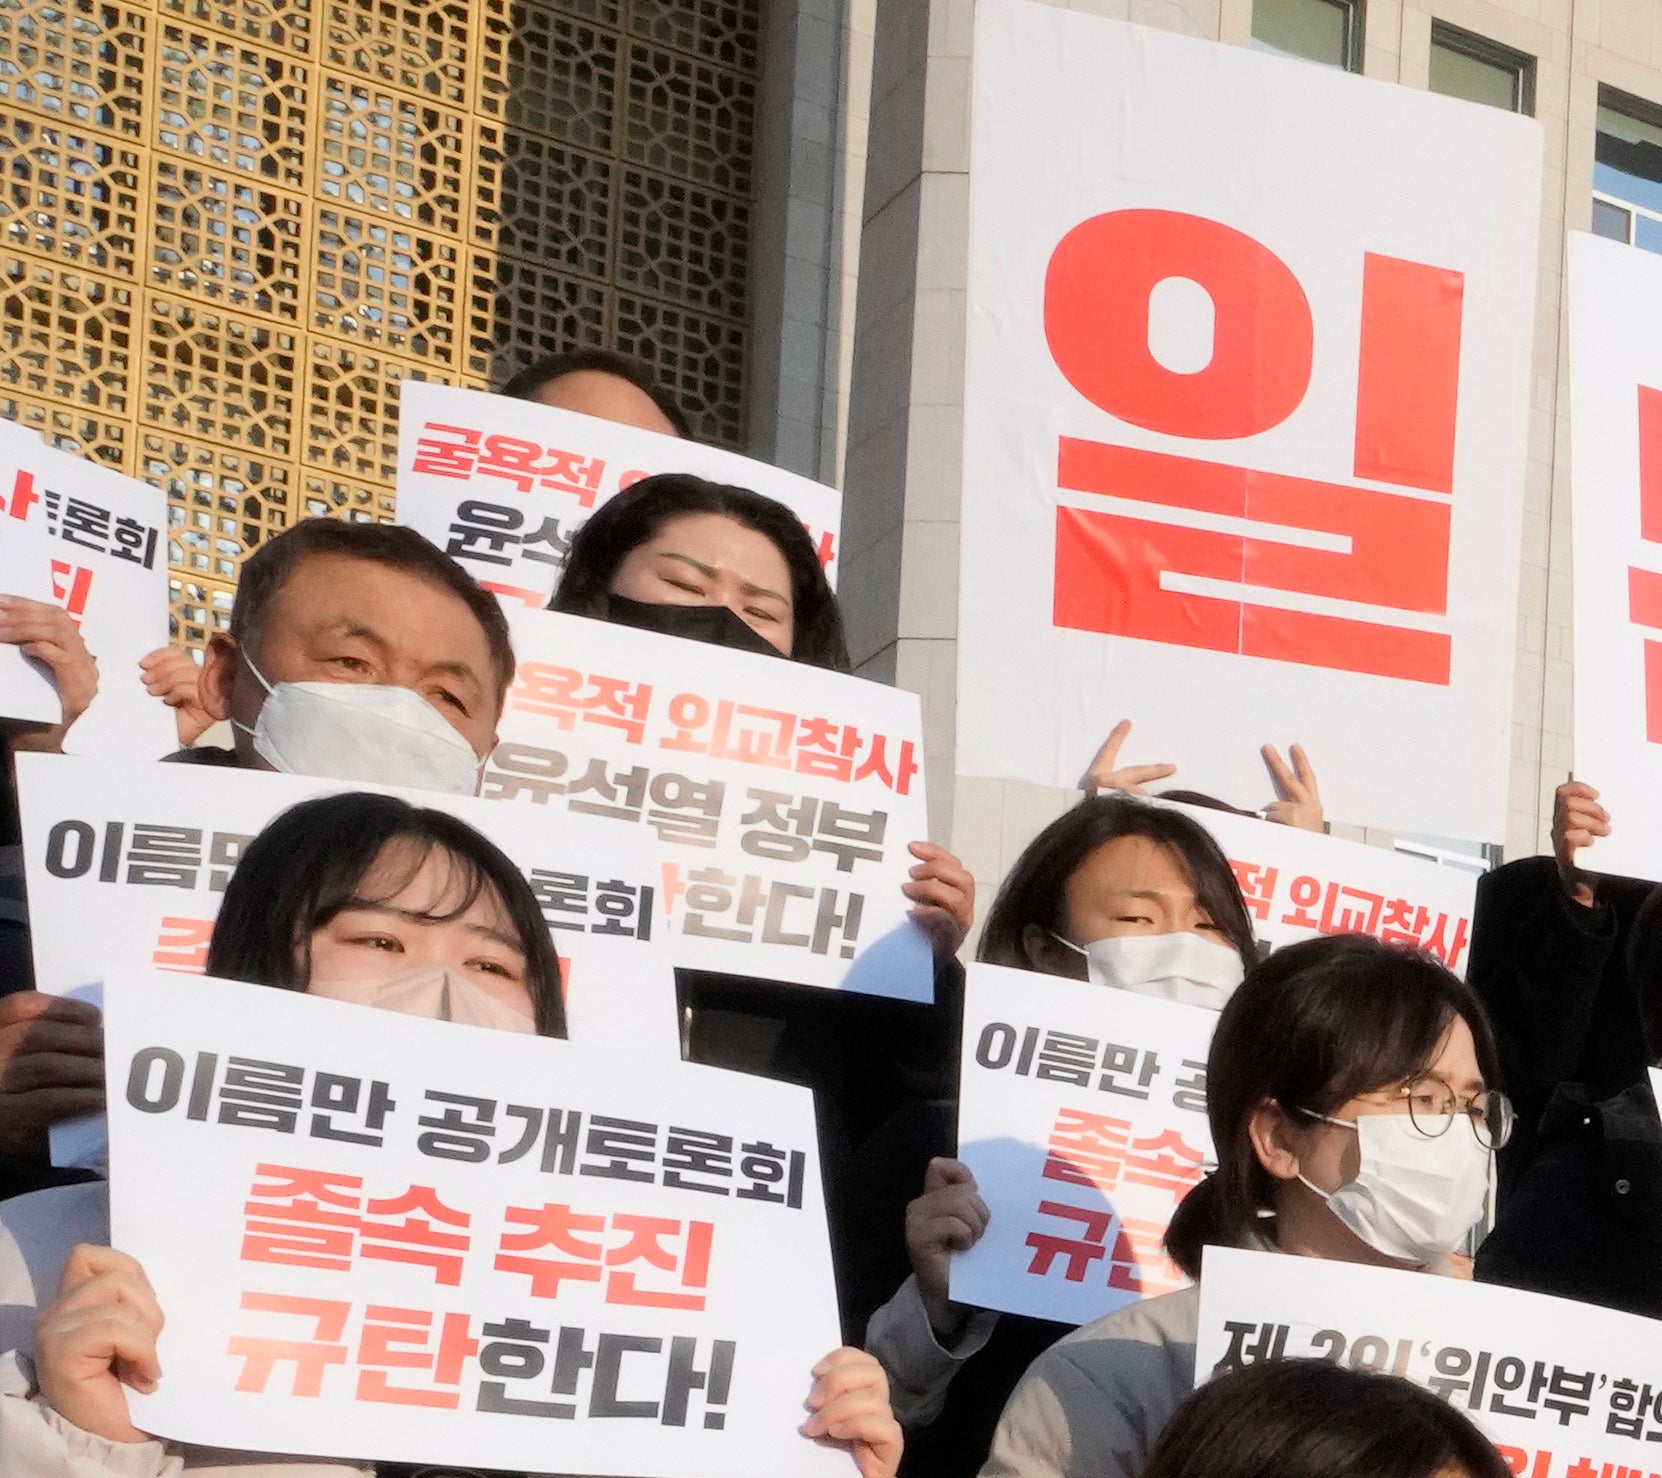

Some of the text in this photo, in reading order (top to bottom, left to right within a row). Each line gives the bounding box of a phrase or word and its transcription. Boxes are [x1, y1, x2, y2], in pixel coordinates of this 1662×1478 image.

[412, 422, 606, 508] 굴욕적
[1042, 206, 1465, 687] 일
[507, 661, 918, 796] 욕적 외교참사
[740, 786, 888, 872] 정부
[660, 862, 865, 959] 한다!
[125, 1045, 807, 1210] 이름만 공개토론회
[975, 1020, 1160, 1100] 이름만
[239, 1162, 715, 1312] 졸속 추진
[226, 1291, 736, 1431] 규탄한다!
